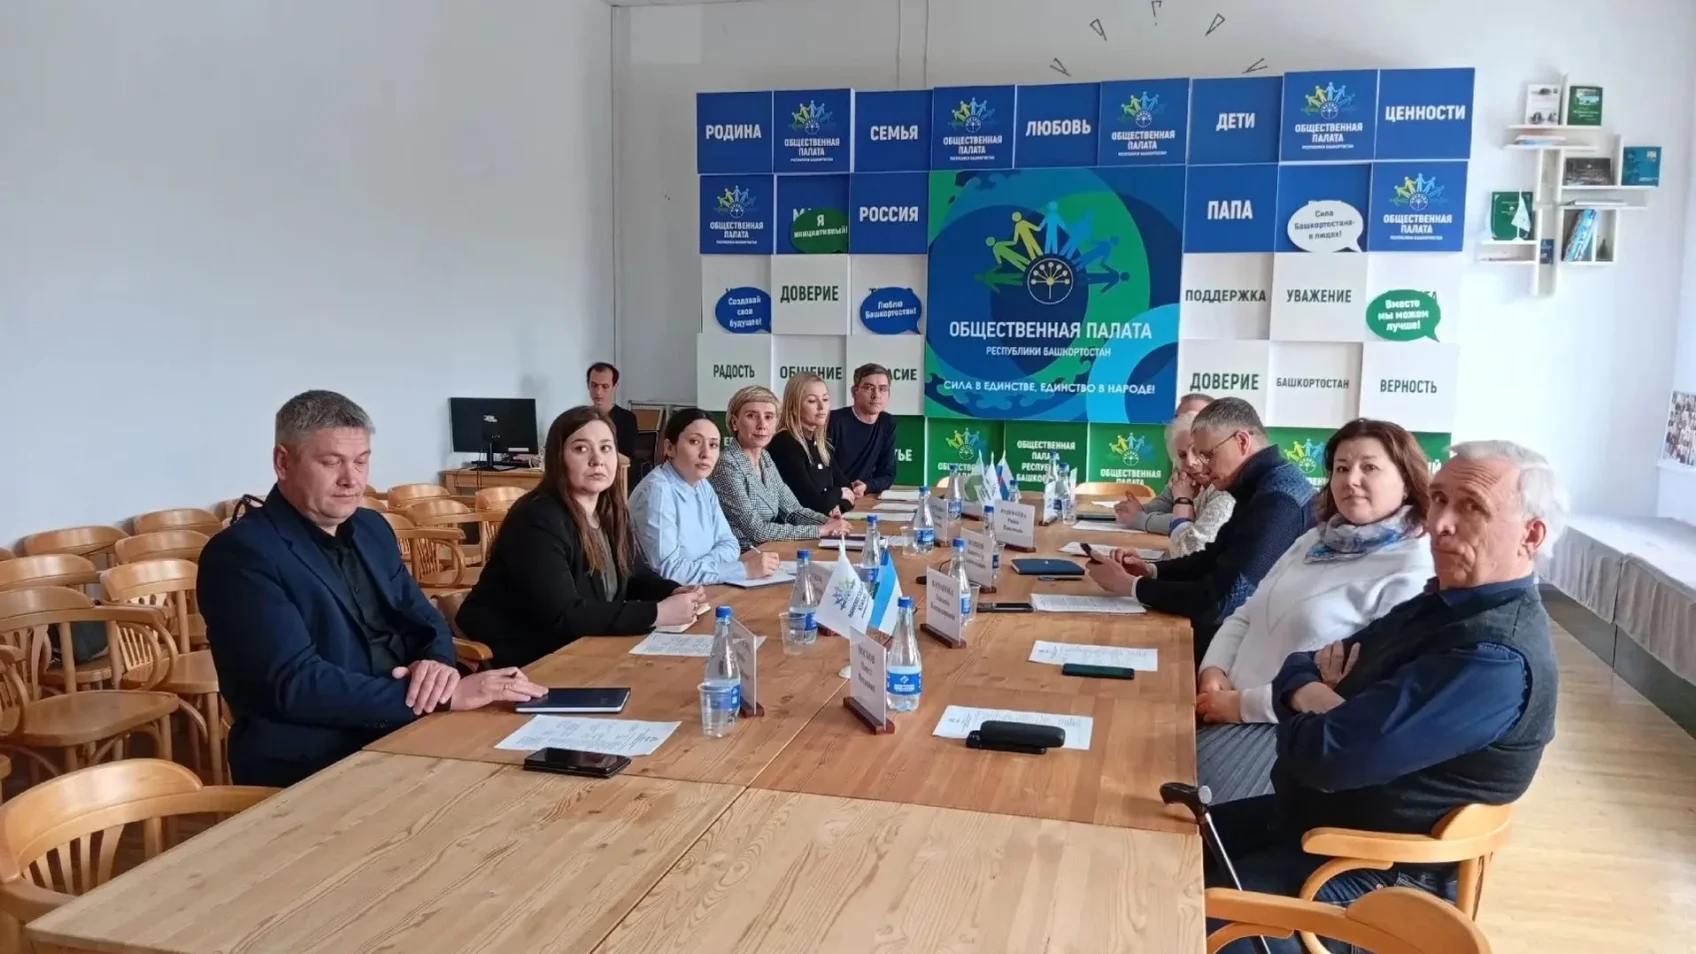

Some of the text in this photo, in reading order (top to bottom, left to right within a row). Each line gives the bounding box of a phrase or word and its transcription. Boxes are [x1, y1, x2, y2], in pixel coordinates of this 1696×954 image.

[1385, 105, 1466, 122] ЦЕННОСТИ
[1025, 119, 1091, 137] ЛЮБОВЬ
[1216, 113, 1255, 132] ДЕТИ
[1295, 122, 1363, 133] ОБЩЕСТВЕННАЯ
[705, 124, 762, 141] РОДИНА
[870, 125, 918, 141] СЕМЬЯ
[1111, 130, 1175, 141] ОБЩЕСТВЕННАЯ
[1312, 133, 1344, 143] ПАЛАТА
[784, 138, 840, 148] ОБЩЕСТВЕННАЯ
[943, 135, 1003, 146] ОБЩЕСТВЕННАЯ
[1127, 140, 1157, 150] ПАЛАТА
[798, 147, 825, 156] ПАЛАТА
[958, 145, 986, 155] ПАЛАТА
[859, 206, 919, 222] РОССИЯ
[1207, 200, 1253, 220] ПАПА
[1315, 210, 1334, 218] Сила
[817, 214, 824, 227] Я
[1383, 214, 1453, 225] ОБЩЕСТВЕННАЯ
[710, 221, 764, 231] ОБЩЕСТВЕННАЯ
[1400, 224, 1433, 234] ПАЛАТА
[724, 230, 749, 239] ПАЛАТА
[1315, 230, 1342, 240] людях!
[780, 285, 839, 303] ДОВЕРИЕ
[1185, 289, 1267, 303] ПОДДЕРЖКА
[1286, 289, 1352, 303] УВАЖЕНИЕ
[728, 295, 762, 306] Создавай
[877, 300, 904, 310] Люблю
[1385, 299, 1421, 309] Вместе
[865, 307, 917, 319] Башкортостан!
[1377, 310, 1429, 321] мы можем
[949, 321, 1153, 340] ОБЩЕСТВЕННАЯ ПАЛАТА
[1386, 320, 1421, 333] лучше!
[986, 346, 1111, 357] РЕСПУБЛИКИ БАШКОРТОСТАН
[713, 364, 755, 379] РАДОСТЬ
[1190, 372, 1260, 391] ДОВЕРИЕ
[1276, 377, 1349, 389] БАШКОРТОСТАН
[1380, 379, 1438, 394] ВЕРНОСТЬ
[943, 380, 1155, 395] СИЛА В ЕДИНСТВЕ, ЕДИНСТВО В НАРОДЕ!
[1016, 440, 1076, 450] ОБЩЕСТВЕННАЯ
[1031, 451, 1060, 460] ПАЛАА
[1100, 468, 1162, 478] ОБЩЕСТВЕННАЯ
